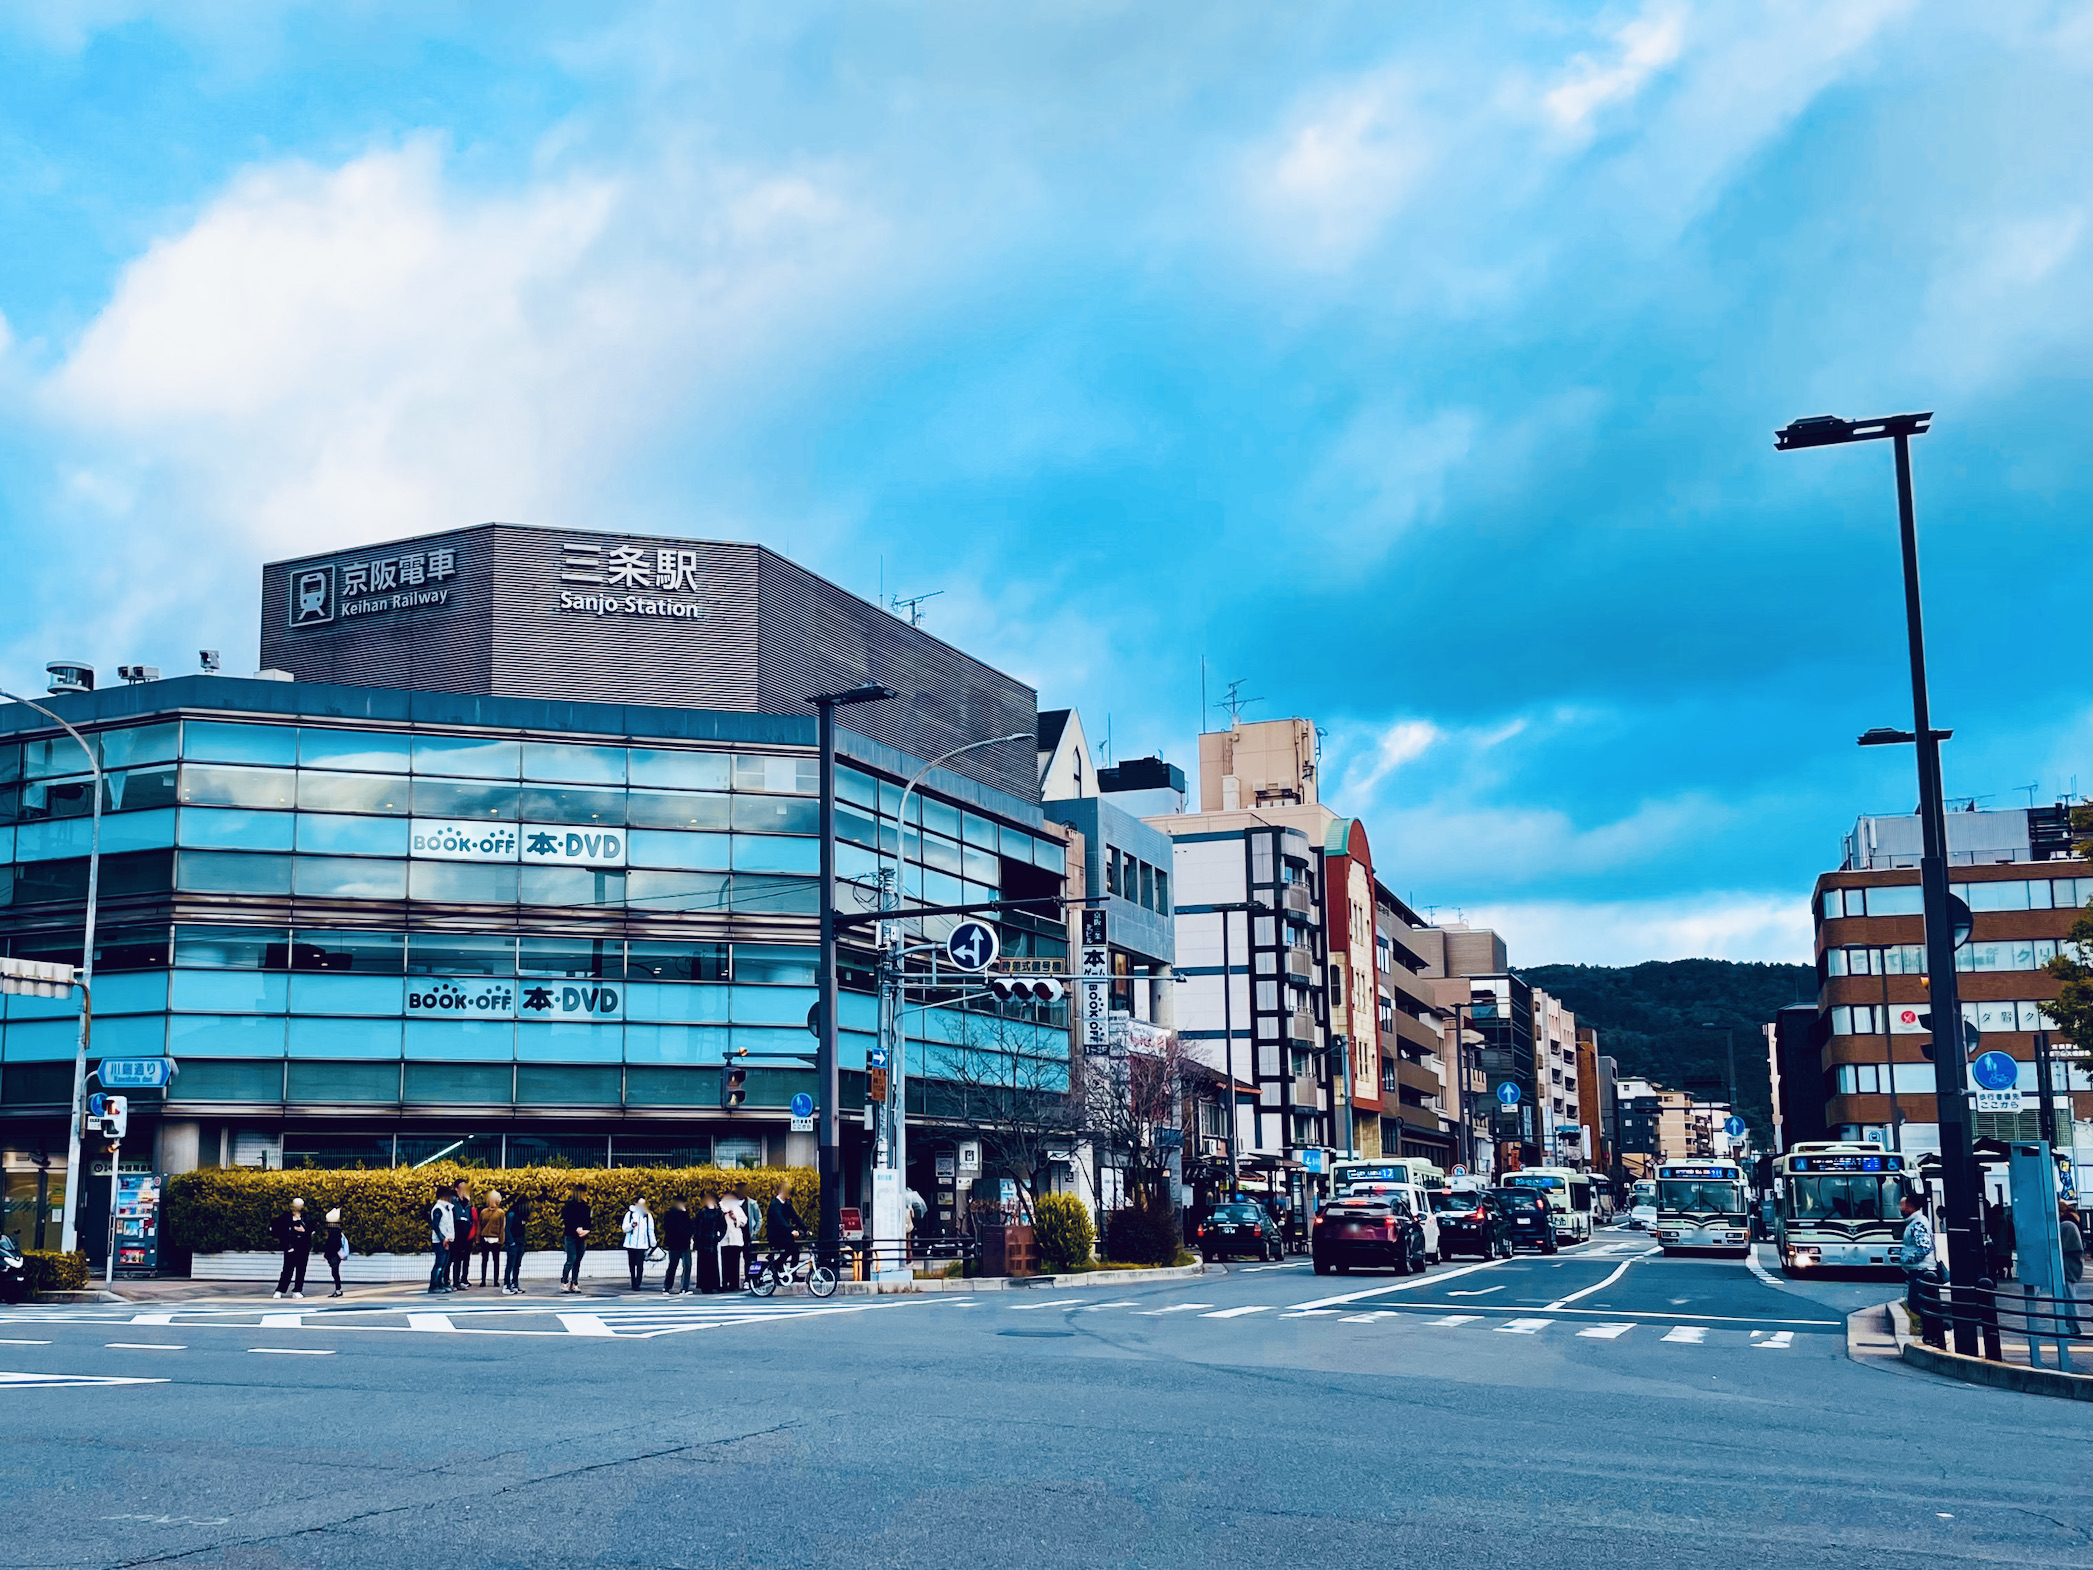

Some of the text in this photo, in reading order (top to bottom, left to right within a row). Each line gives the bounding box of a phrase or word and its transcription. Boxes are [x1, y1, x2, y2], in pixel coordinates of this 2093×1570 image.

[343, 549, 455, 596] 京阪電車
[561, 544, 697, 592] 三条駅
[341, 590, 448, 617] Keihan Railway
[560, 591, 698, 617] Sanjo Station
[1084, 949, 1105, 967] 本
